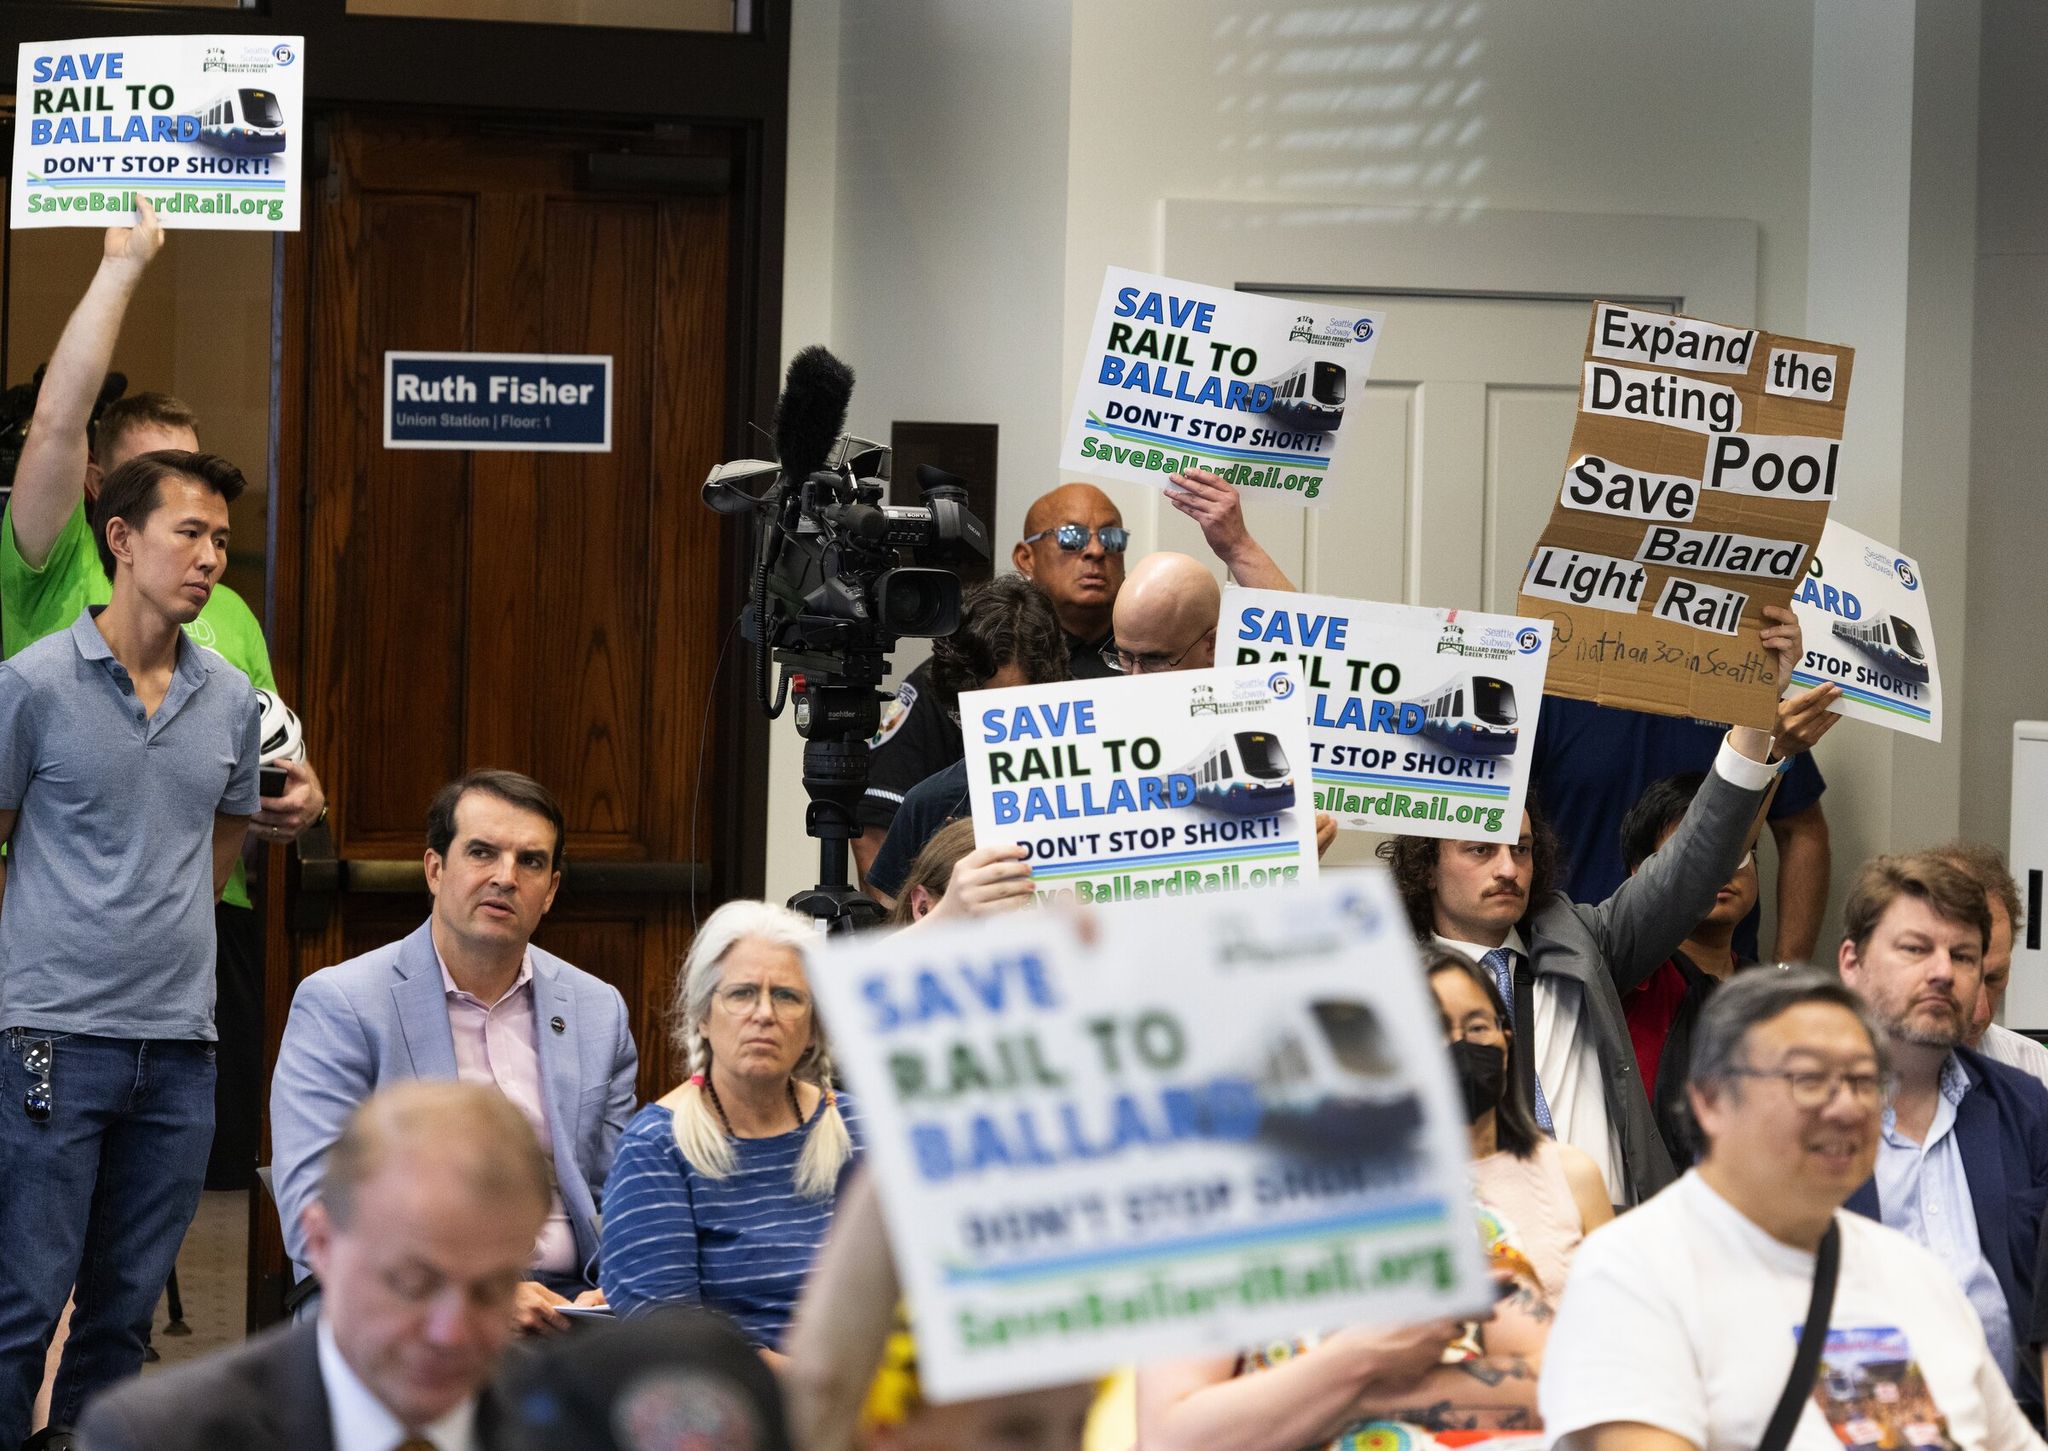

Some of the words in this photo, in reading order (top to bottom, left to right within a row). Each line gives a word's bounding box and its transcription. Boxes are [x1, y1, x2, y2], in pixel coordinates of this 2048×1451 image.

[33, 53, 123, 83] SAVE
[33, 86, 113, 114] RAIL
[126, 85, 174, 110] TO
[31, 115, 200, 145] BALLARD
[44, 157, 115, 174] DON'T
[122, 157, 179, 173] STOP
[186, 158, 270, 174] SHORT!
[1114, 287, 1216, 334] SAVE
[1330, 318, 1353, 328] Seattle
[1106, 322, 1195, 367] RAIL
[1210, 341, 1258, 377] TO
[1325, 327, 1351, 338] Subway
[1602, 309, 1755, 365] Expand
[1774, 354, 1832, 393] the
[397, 374, 477, 402] Ruth
[489, 376, 594, 405] Fisher
[1098, 355, 1275, 414] BALLARD
[1592, 367, 1735, 433] Dating
[396, 413, 436, 426] Union
[440, 414, 489, 428] Station
[501, 414, 541, 428] Floor:
[544, 416, 551, 428] 1
[1106, 401, 1183, 433] DON'T
[1188, 419, 1247, 444] STOP
[1250, 428, 1323, 452] SHORT!
[1712, 436, 1839, 495] Pool
[1570, 457, 1695, 519] Save
[1644, 527, 1802, 576] Ballard
[1865, 546, 1892, 566] Seattle
[1533, 551, 1644, 604] Light
[1661, 580, 1745, 632] Rail
[1238, 607, 1349, 650] SAVE
[1480, 636, 1513, 649] Subway
[1486, 627, 1514, 637] Seattle
[1490, 648, 1516, 656] FREMONT
[1347, 660, 1401, 695] TO
[1805, 651, 1852, 677] STOP
[1857, 666, 1918, 700] SHORT!
[982, 700, 1097, 744] SAVE
[989, 744, 1091, 785] RAIL
[1102, 737, 1162, 773] TO
[1331, 746, 1397, 769] STOP
[1403, 752, 1496, 779] SHORT!
[992, 773, 1197, 825] BALLARD
[1110, 826, 1176, 851] STOP
[1184, 817, 1280, 846] SHORT!
[860, 950, 1057, 1031] SAVE
[887, 1027, 1068, 1098] RAIL
[1087, 1005, 1188, 1073] TO
